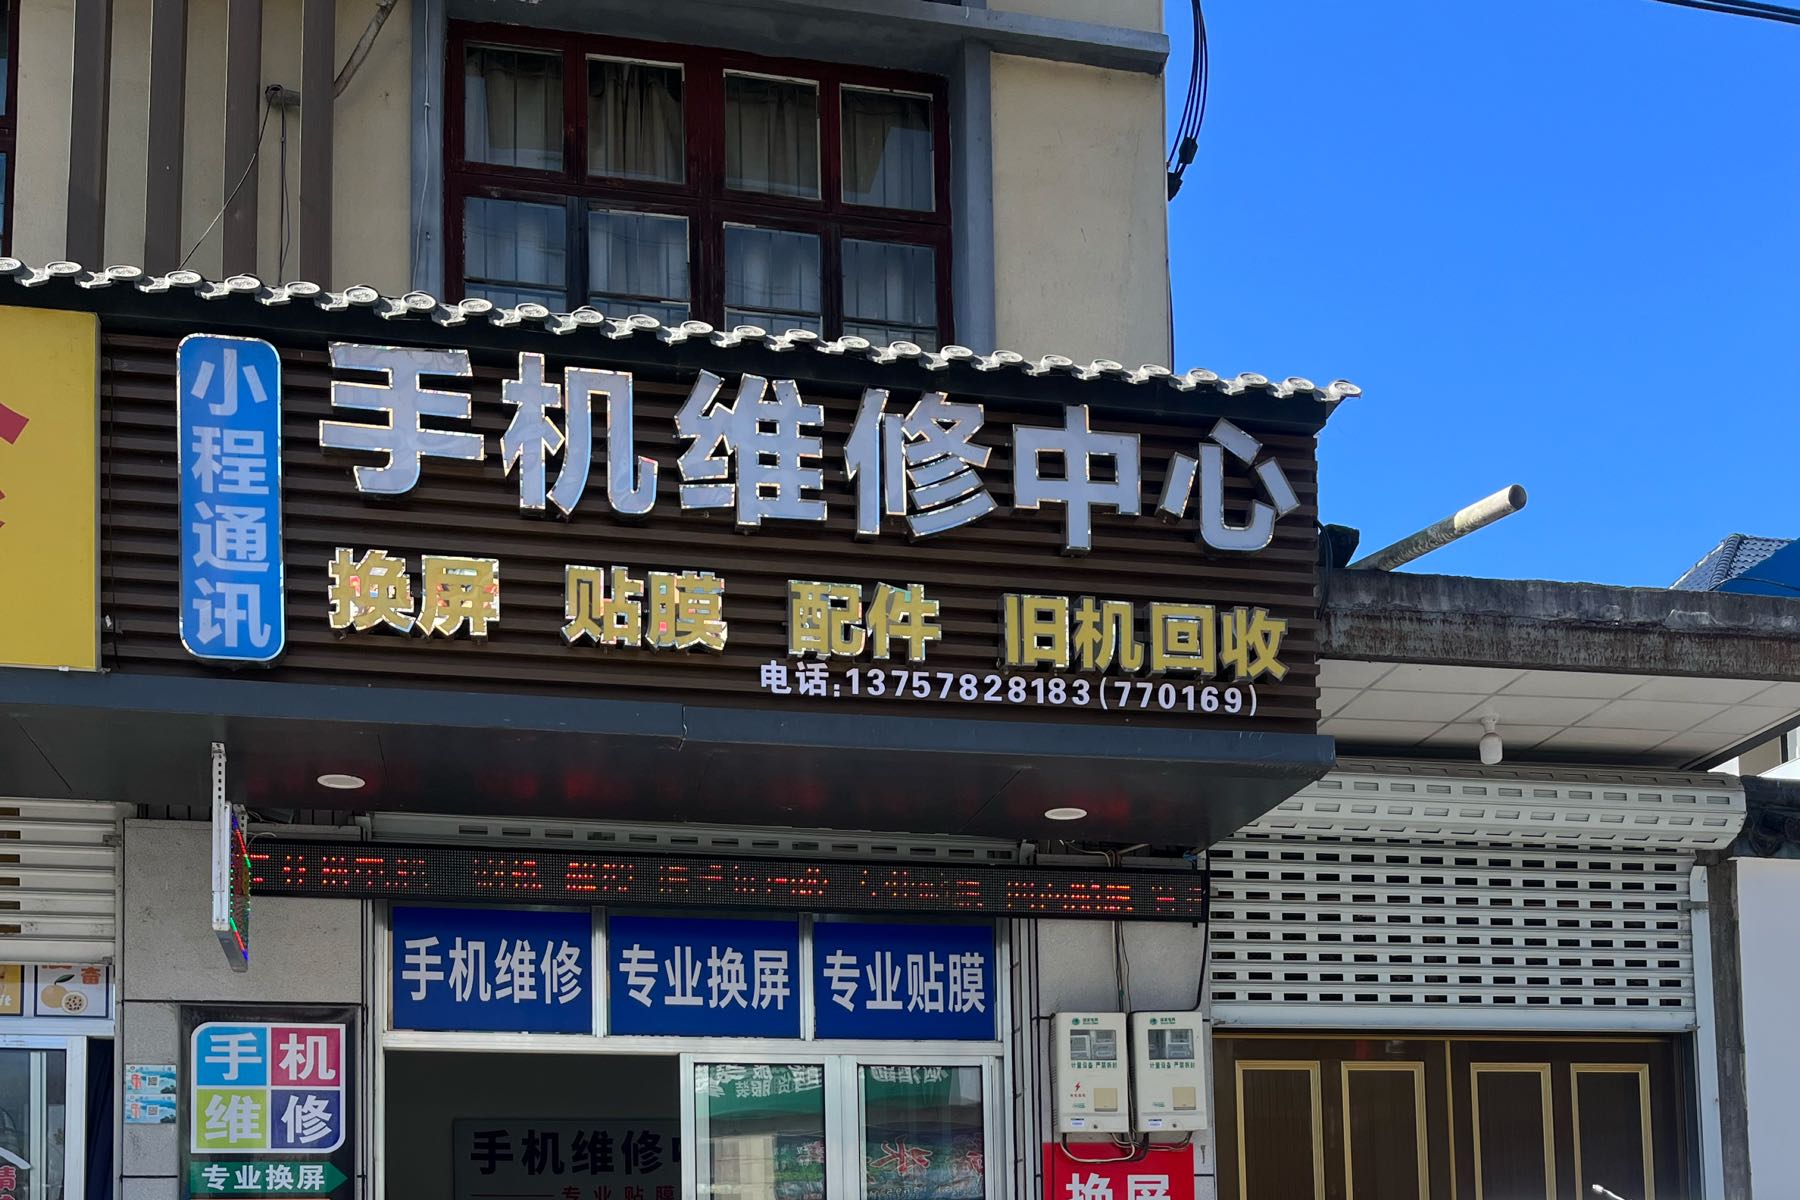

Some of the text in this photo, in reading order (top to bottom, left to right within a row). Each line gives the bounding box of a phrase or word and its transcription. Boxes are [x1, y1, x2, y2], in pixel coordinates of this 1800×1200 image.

[319, 341, 1300, 555] 手机维修中心
[191, 347, 271, 649] 小程通讯
[328, 547, 1289, 683] 换屏 贴膜 配件 旧机回收
[402, 936, 583, 1004] 手机维修
[619, 943, 791, 1010] 专业换屏
[823, 949, 986, 1013] 专业贴膜
[205, 1032, 336, 1082] 手机
[204, 1093, 333, 1145] 维修
[201, 1163, 325, 1192] 专业换屏
[470, 1129, 681, 1176] 手机维修
